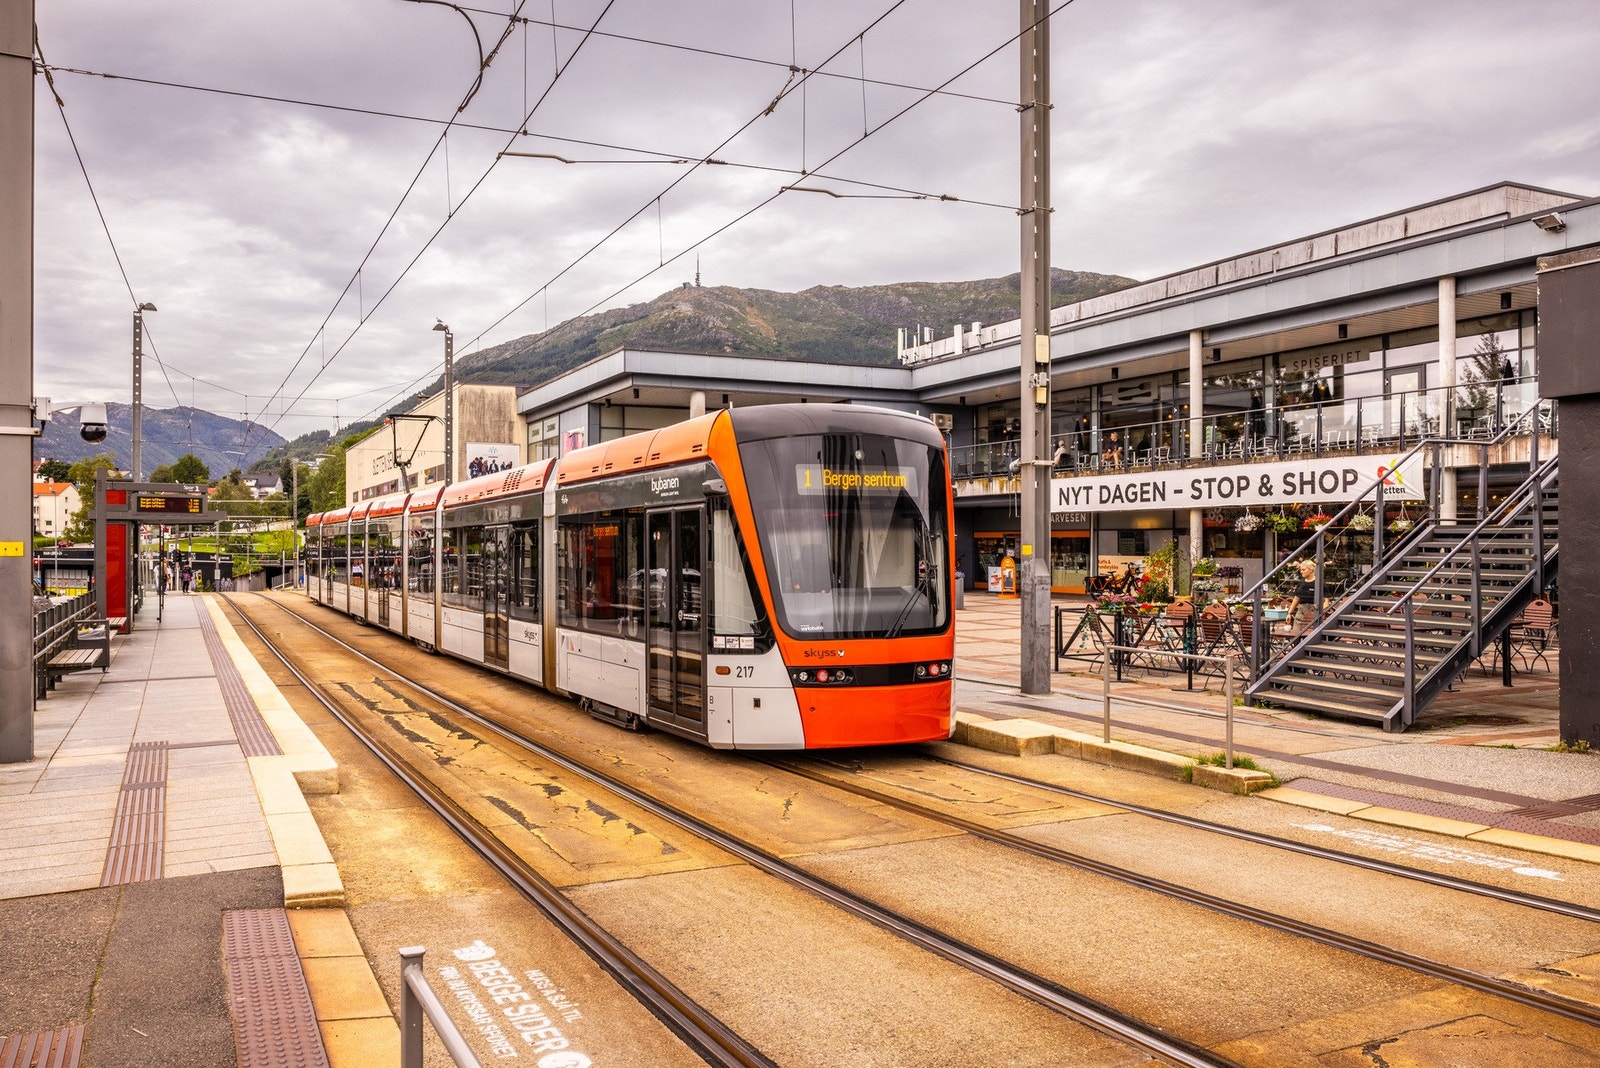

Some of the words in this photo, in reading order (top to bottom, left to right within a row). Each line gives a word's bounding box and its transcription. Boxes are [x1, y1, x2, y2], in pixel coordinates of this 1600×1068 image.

[1292, 350, 1361, 371] SPISERIET
[651, 476, 679, 494] bybanen
[804, 469, 812, 487] 1
[822, 469, 861, 490] Bergen
[863, 470, 907, 488] sentrum
[1058, 485, 1093, 506] NYT
[1099, 481, 1166, 504] DAGEN
[1190, 475, 1250, 500] STOP
[1258, 473, 1273, 497] &
[1282, 468, 1358, 495] SHOP
[1383, 486, 1406, 495] etten
[1051, 512, 1087, 523] ARVESEN
[804, 648, 836, 659] skyss
[736, 666, 754, 678] 217
[467, 959, 531, 1006] BEGGE
[503, 1003, 569, 1054] SIDER
